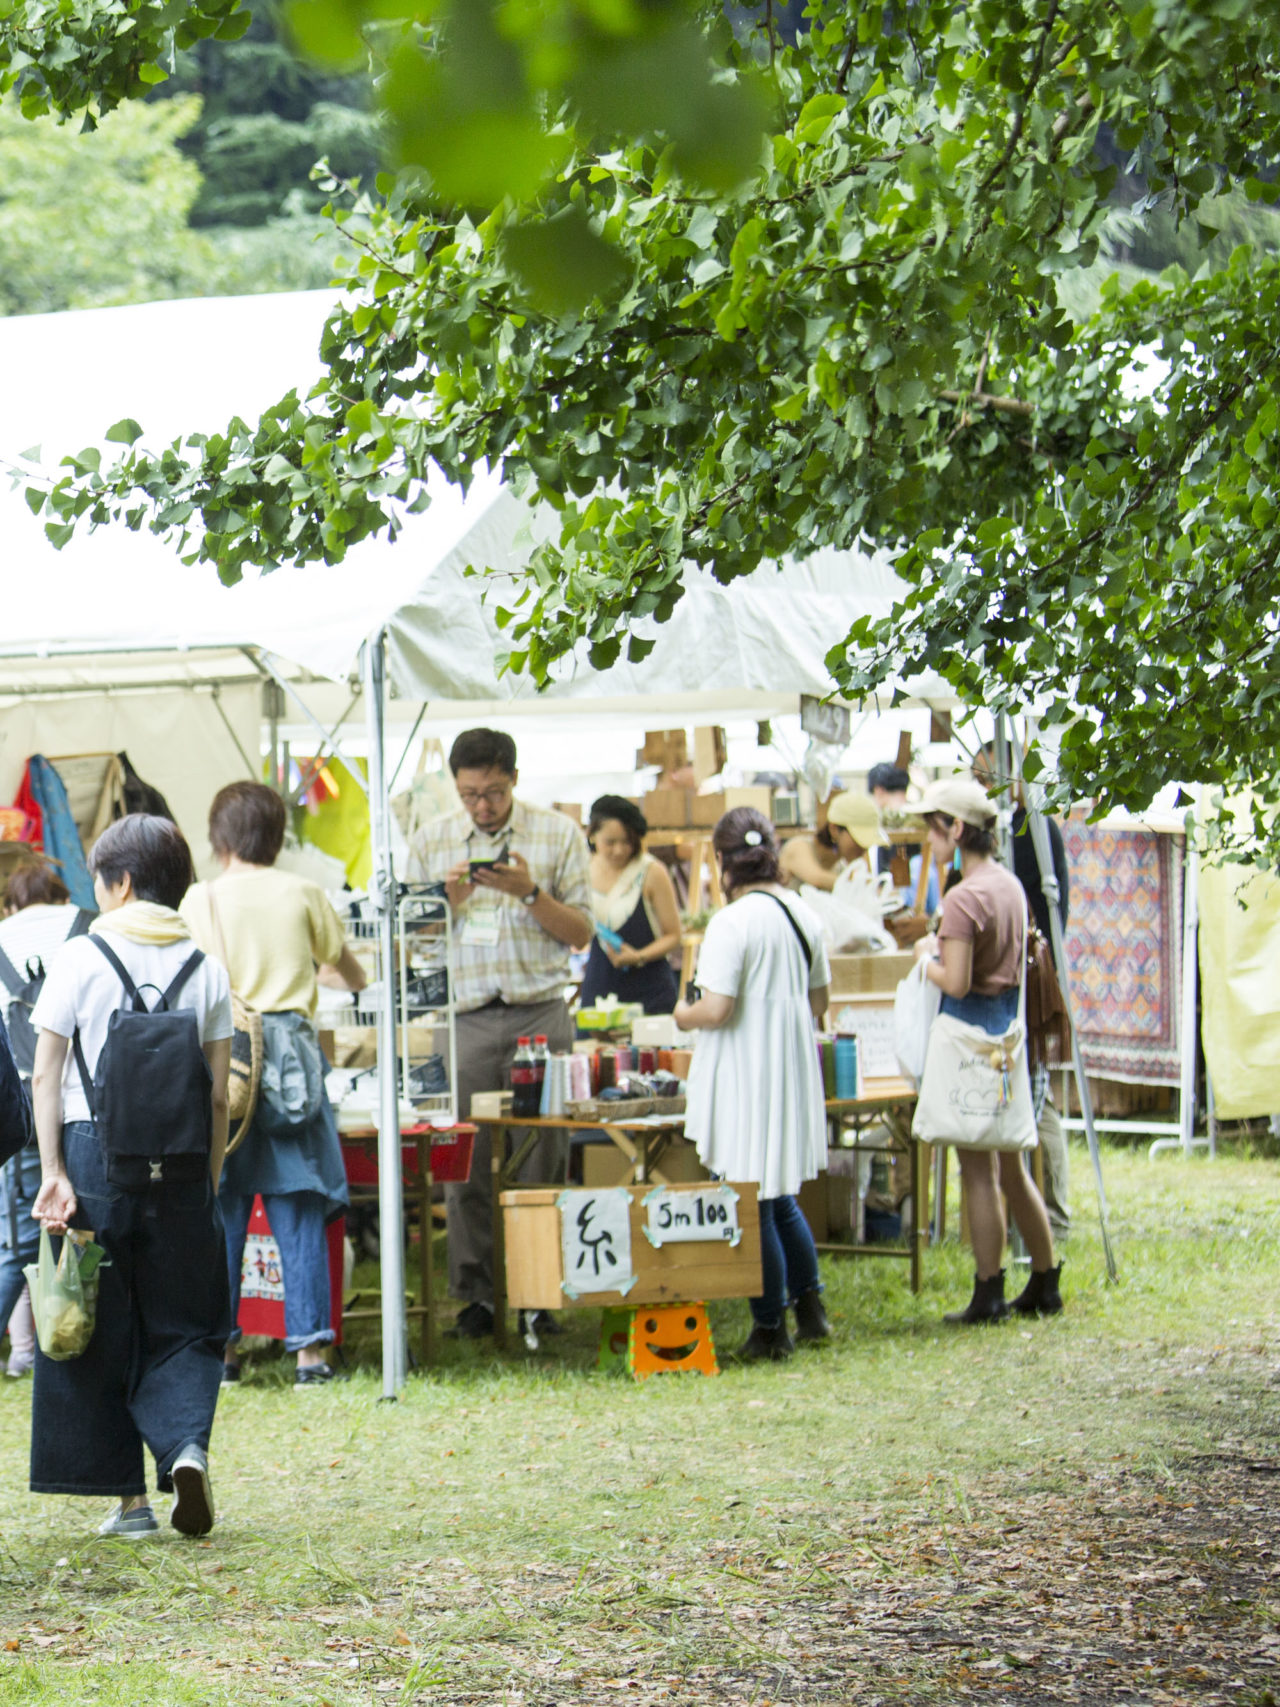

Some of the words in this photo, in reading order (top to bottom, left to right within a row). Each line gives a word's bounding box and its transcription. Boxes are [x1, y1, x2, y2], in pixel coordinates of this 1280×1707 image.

[657, 1202, 691, 1229] 5m
[693, 1197, 728, 1227] 100
[576, 1199, 618, 1276] 糸
[723, 1228, 734, 1240] 円
